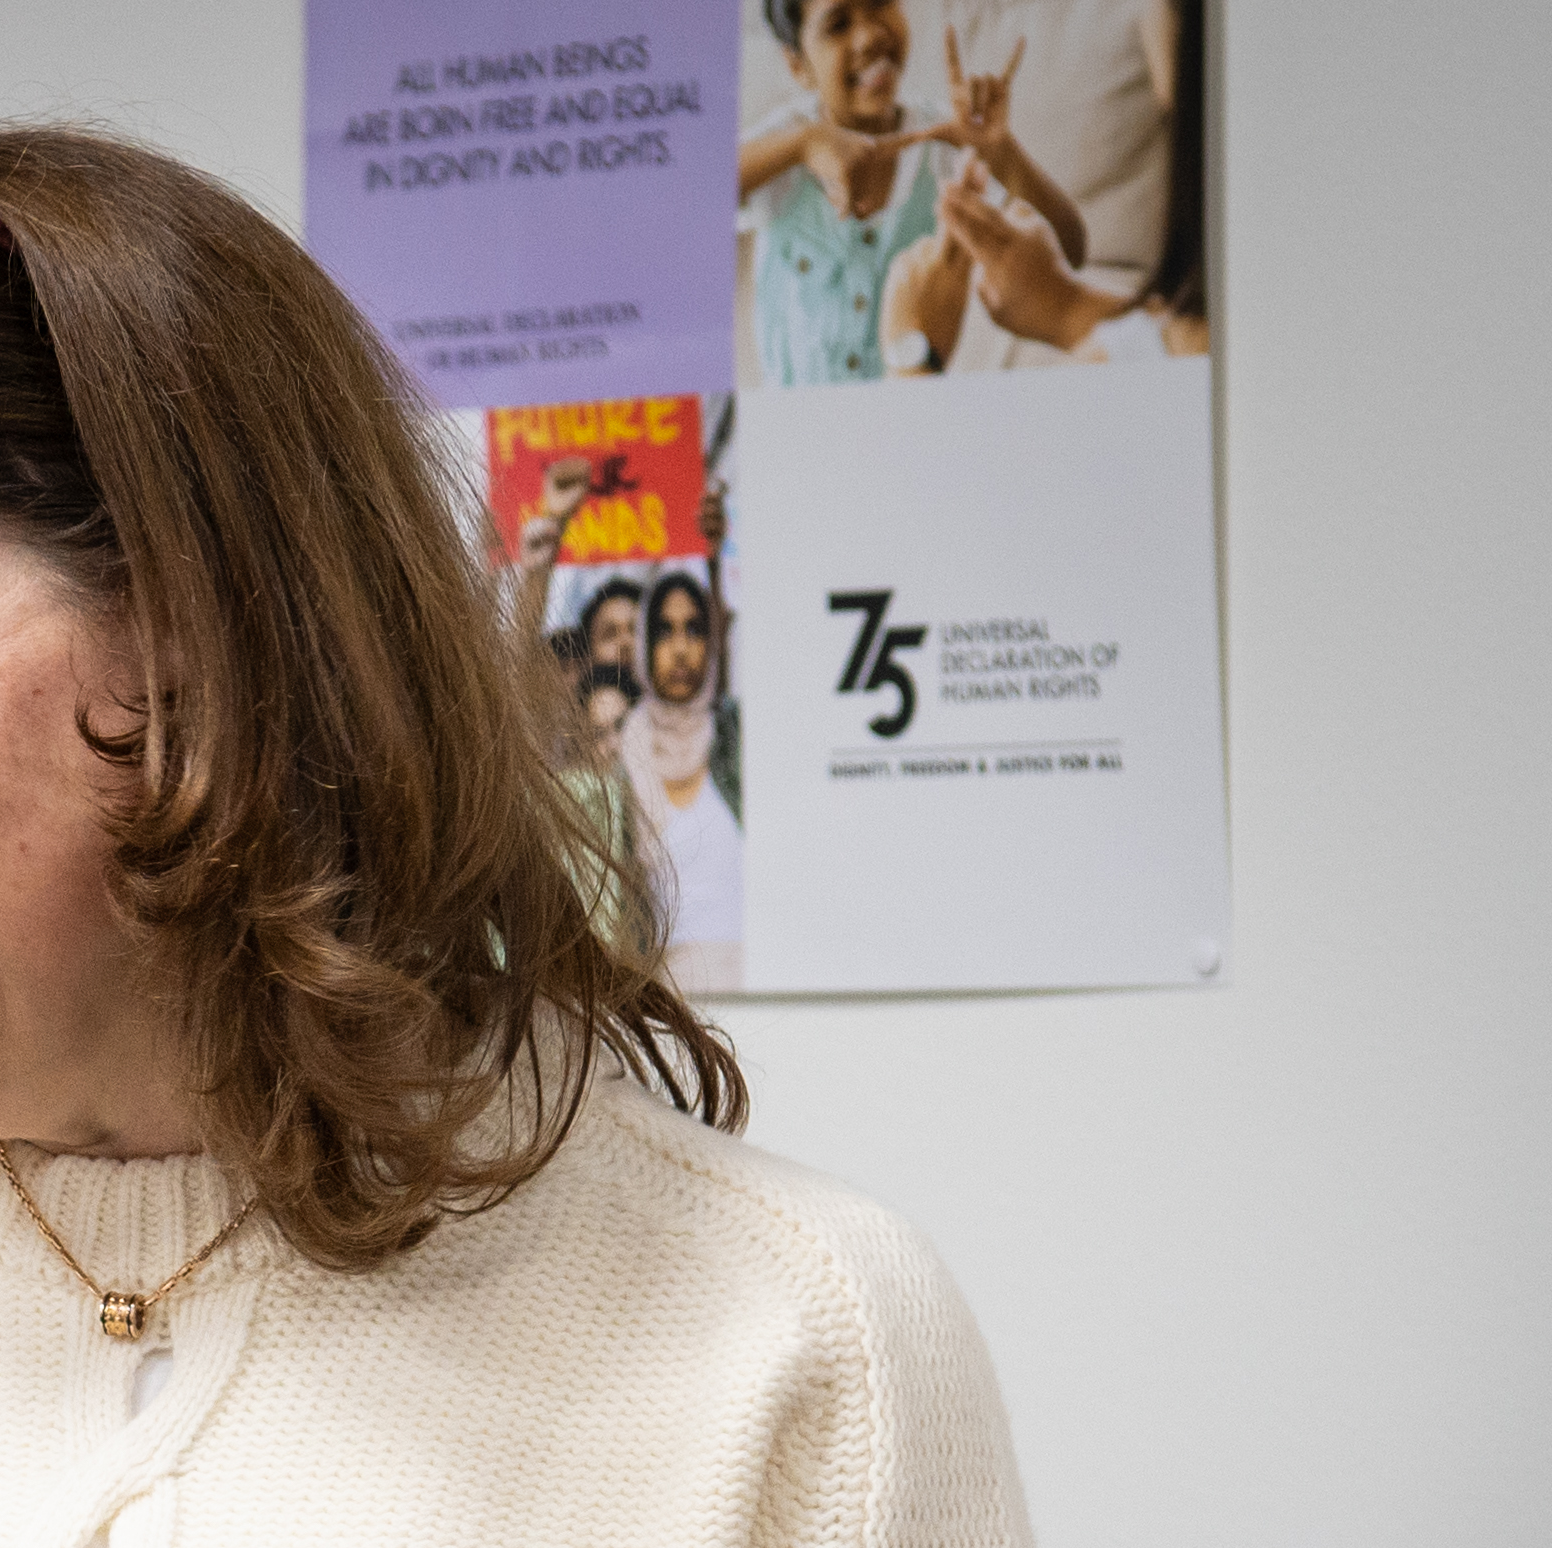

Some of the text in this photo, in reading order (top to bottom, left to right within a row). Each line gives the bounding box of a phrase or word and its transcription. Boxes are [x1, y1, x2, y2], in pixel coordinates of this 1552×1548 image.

[397, 36, 650, 95] ALL HUMAN BEINGS
[344, 80, 702, 146] ARE BORN FREE AND EQUAL
[365, 131, 671, 193] IN DIGNITY AND RIGHTS
[941, 618, 1050, 645] UNIVERSAL
[941, 641, 1119, 674] DECLARATION OF
[827, 588, 928, 739] 75
[941, 671, 1101, 702] HUMAN RIGHTS
